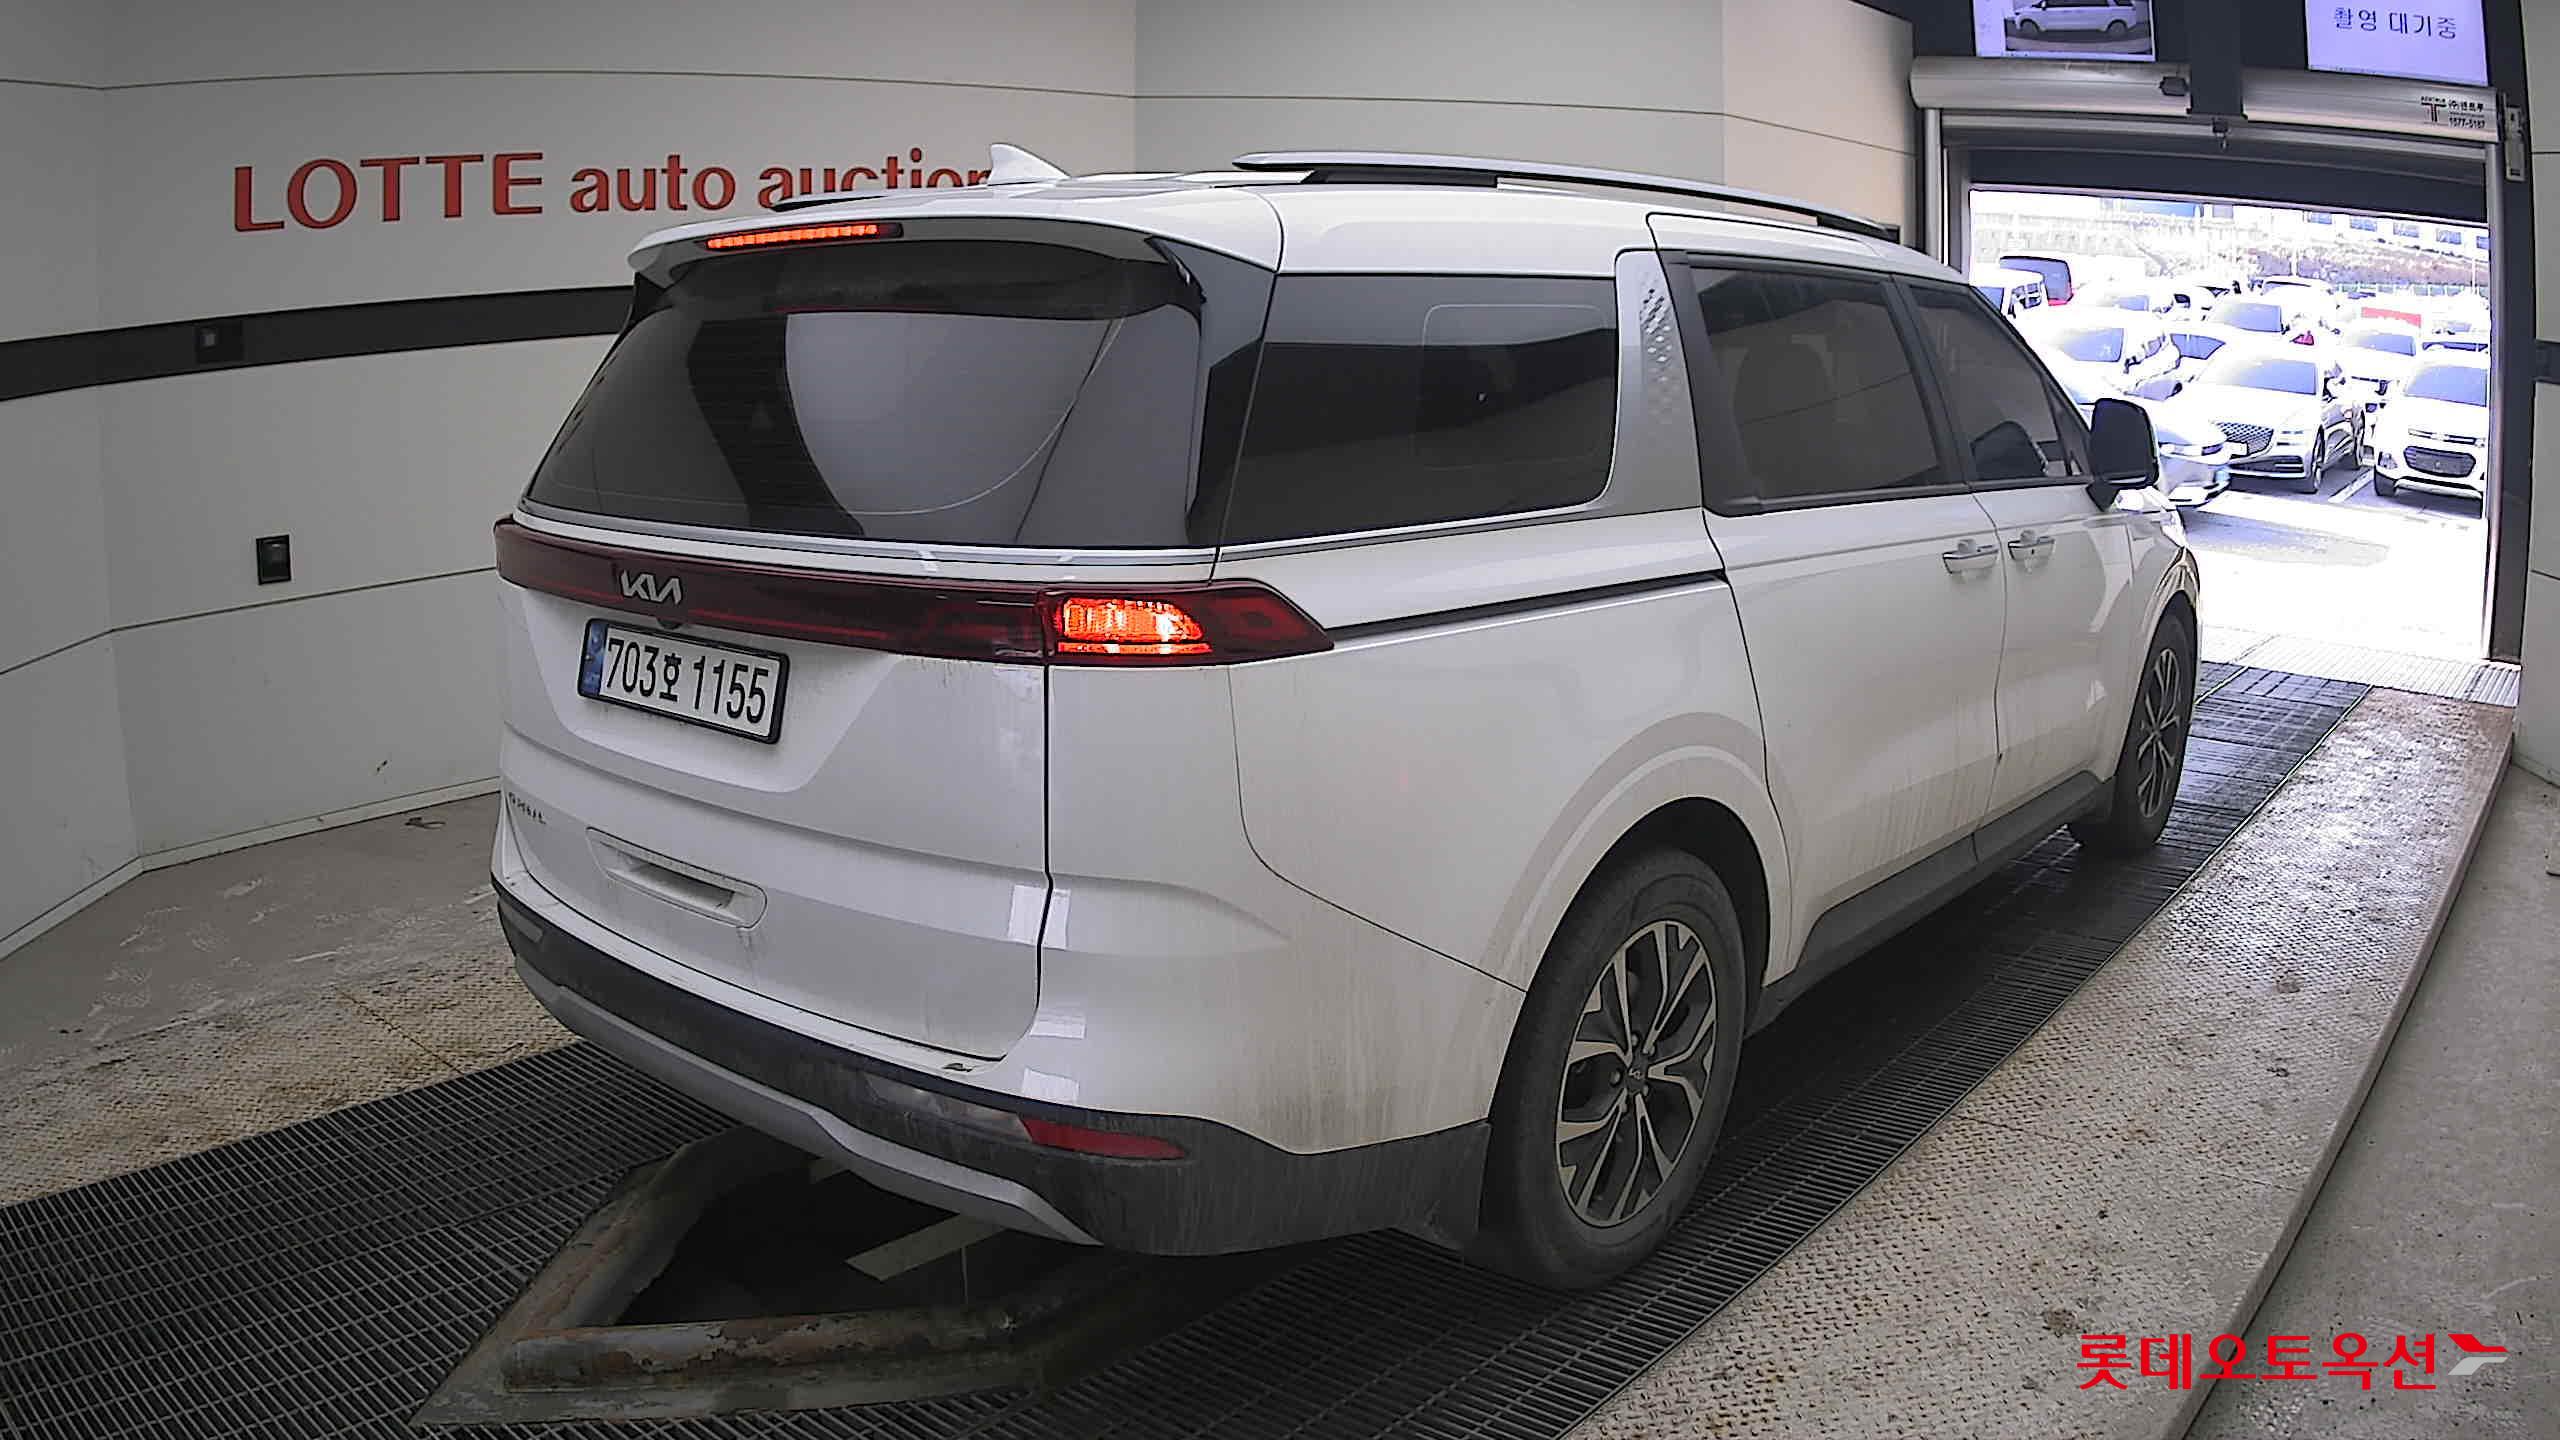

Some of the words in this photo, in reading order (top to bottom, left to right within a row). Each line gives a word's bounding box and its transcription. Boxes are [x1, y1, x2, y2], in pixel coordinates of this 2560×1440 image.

[2389, 12, 2457, 39] 대기중
[233, 152, 544, 233] LOTTE
[568, 153, 737, 213] auto
[605, 637, 681, 703] 703호
[693, 655, 769, 724] 1155
